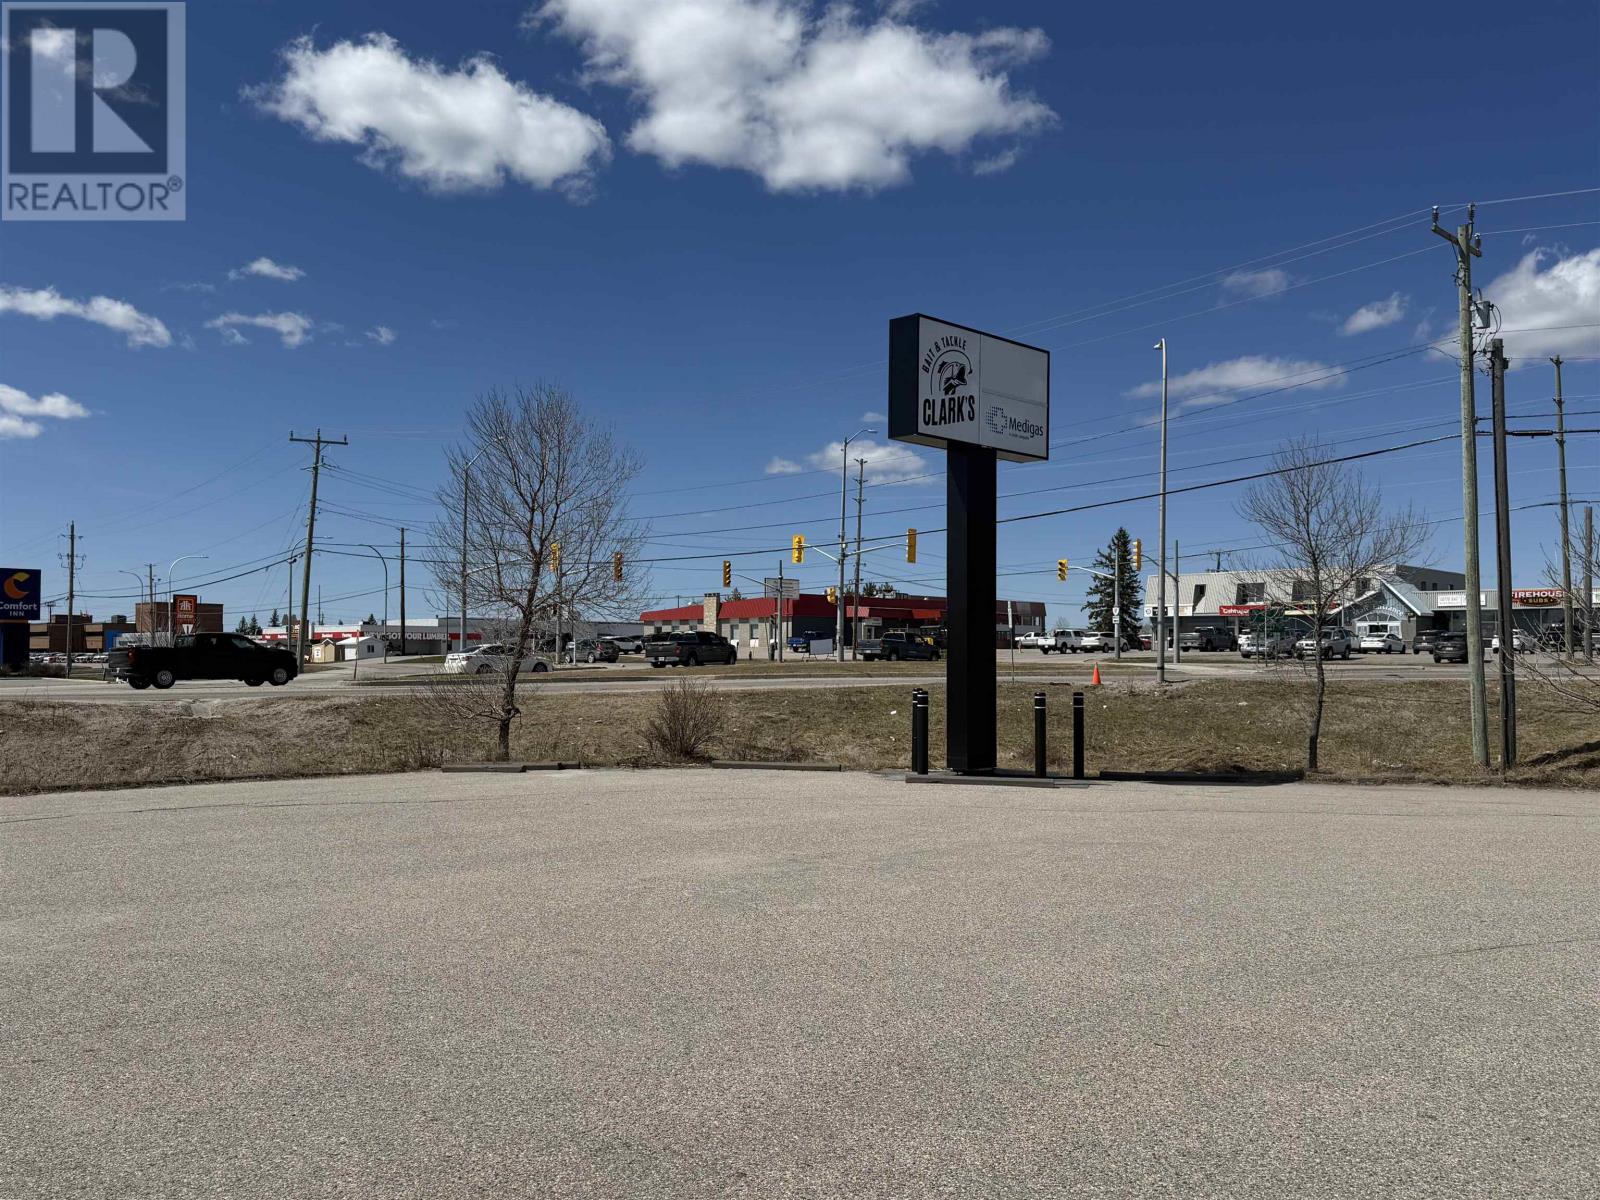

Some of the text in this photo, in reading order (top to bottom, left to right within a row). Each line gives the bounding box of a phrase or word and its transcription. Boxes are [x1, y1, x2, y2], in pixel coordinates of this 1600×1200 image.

[922, 335, 967, 374] BAIT & TACKLE
[923, 394, 975, 427] CLARK'S
[1009, 416, 1044, 438] Medigas
[1511, 590, 1566, 599] IREHOUS
[404, 632, 422, 640] OUR
